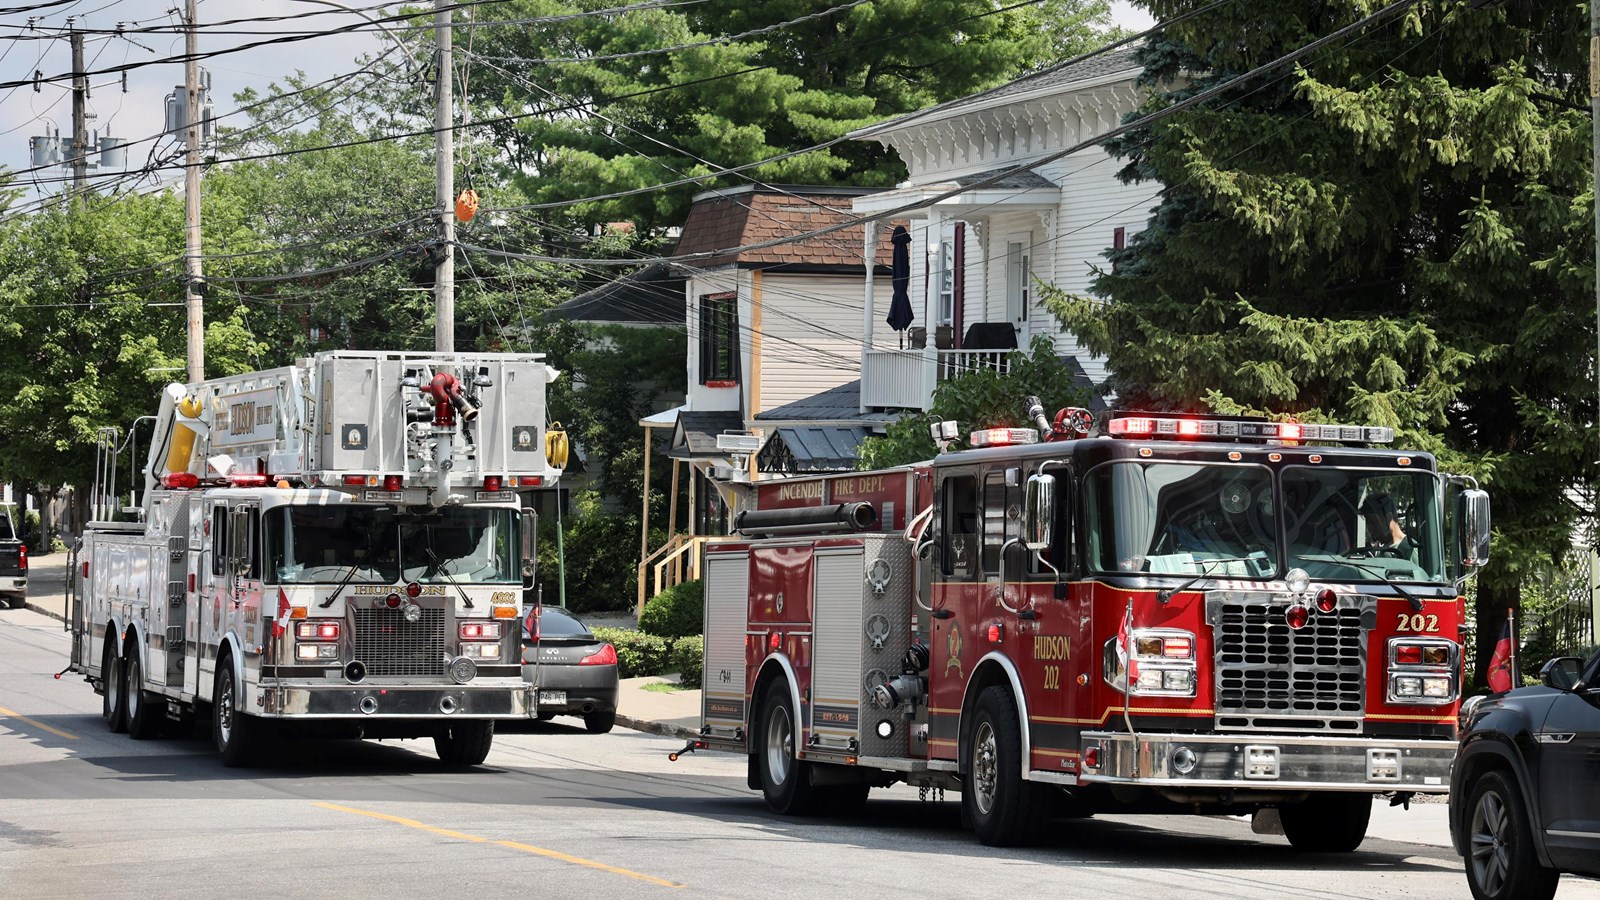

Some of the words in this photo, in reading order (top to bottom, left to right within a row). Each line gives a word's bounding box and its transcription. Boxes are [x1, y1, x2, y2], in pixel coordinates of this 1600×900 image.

[231, 401, 255, 435] HUDSON
[780, 482, 822, 500] INCENDIE
[835, 478, 854, 496] FIRE
[859, 475, 885, 493] DEPT.
[1220, 579, 1358, 593] HUDON
[1396, 613, 1440, 632] 202
[1034, 635, 1071, 661] HUDSON
[1044, 665, 1060, 690] 202
